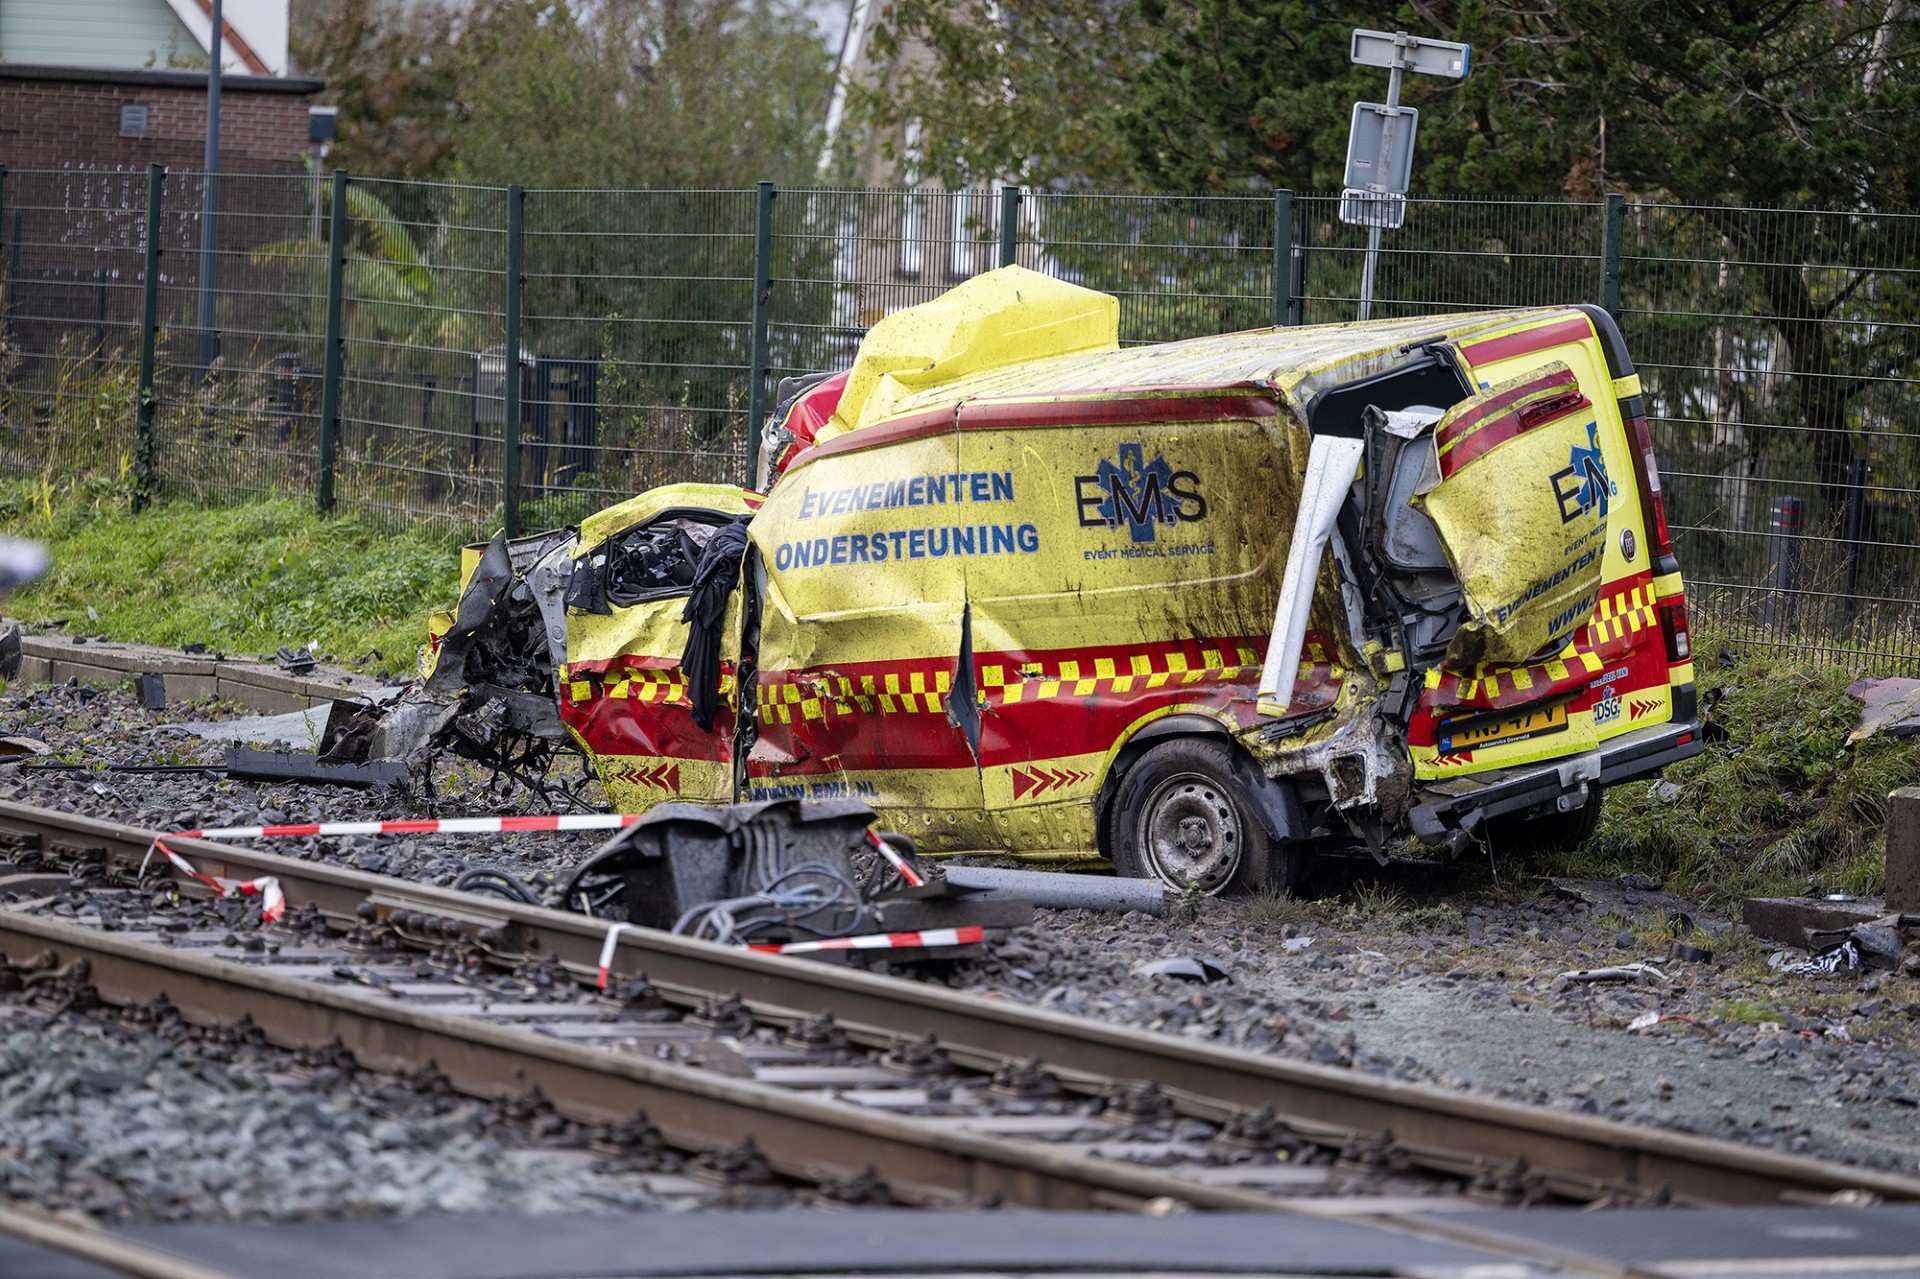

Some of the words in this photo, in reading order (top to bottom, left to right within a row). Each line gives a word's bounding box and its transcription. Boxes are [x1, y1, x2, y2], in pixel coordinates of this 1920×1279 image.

[798, 471, 1014, 520] EVENEMENTEN
[775, 523, 1039, 571] ONDERSTEUNING
[1084, 549, 1117, 560] EVENT
[1121, 548, 1166, 559] MEDICAL
[1168, 545, 1214, 557] SERVICE
[1564, 534, 1588, 556] EVENT
[1496, 547, 1597, 624] EVENEMENTEN
